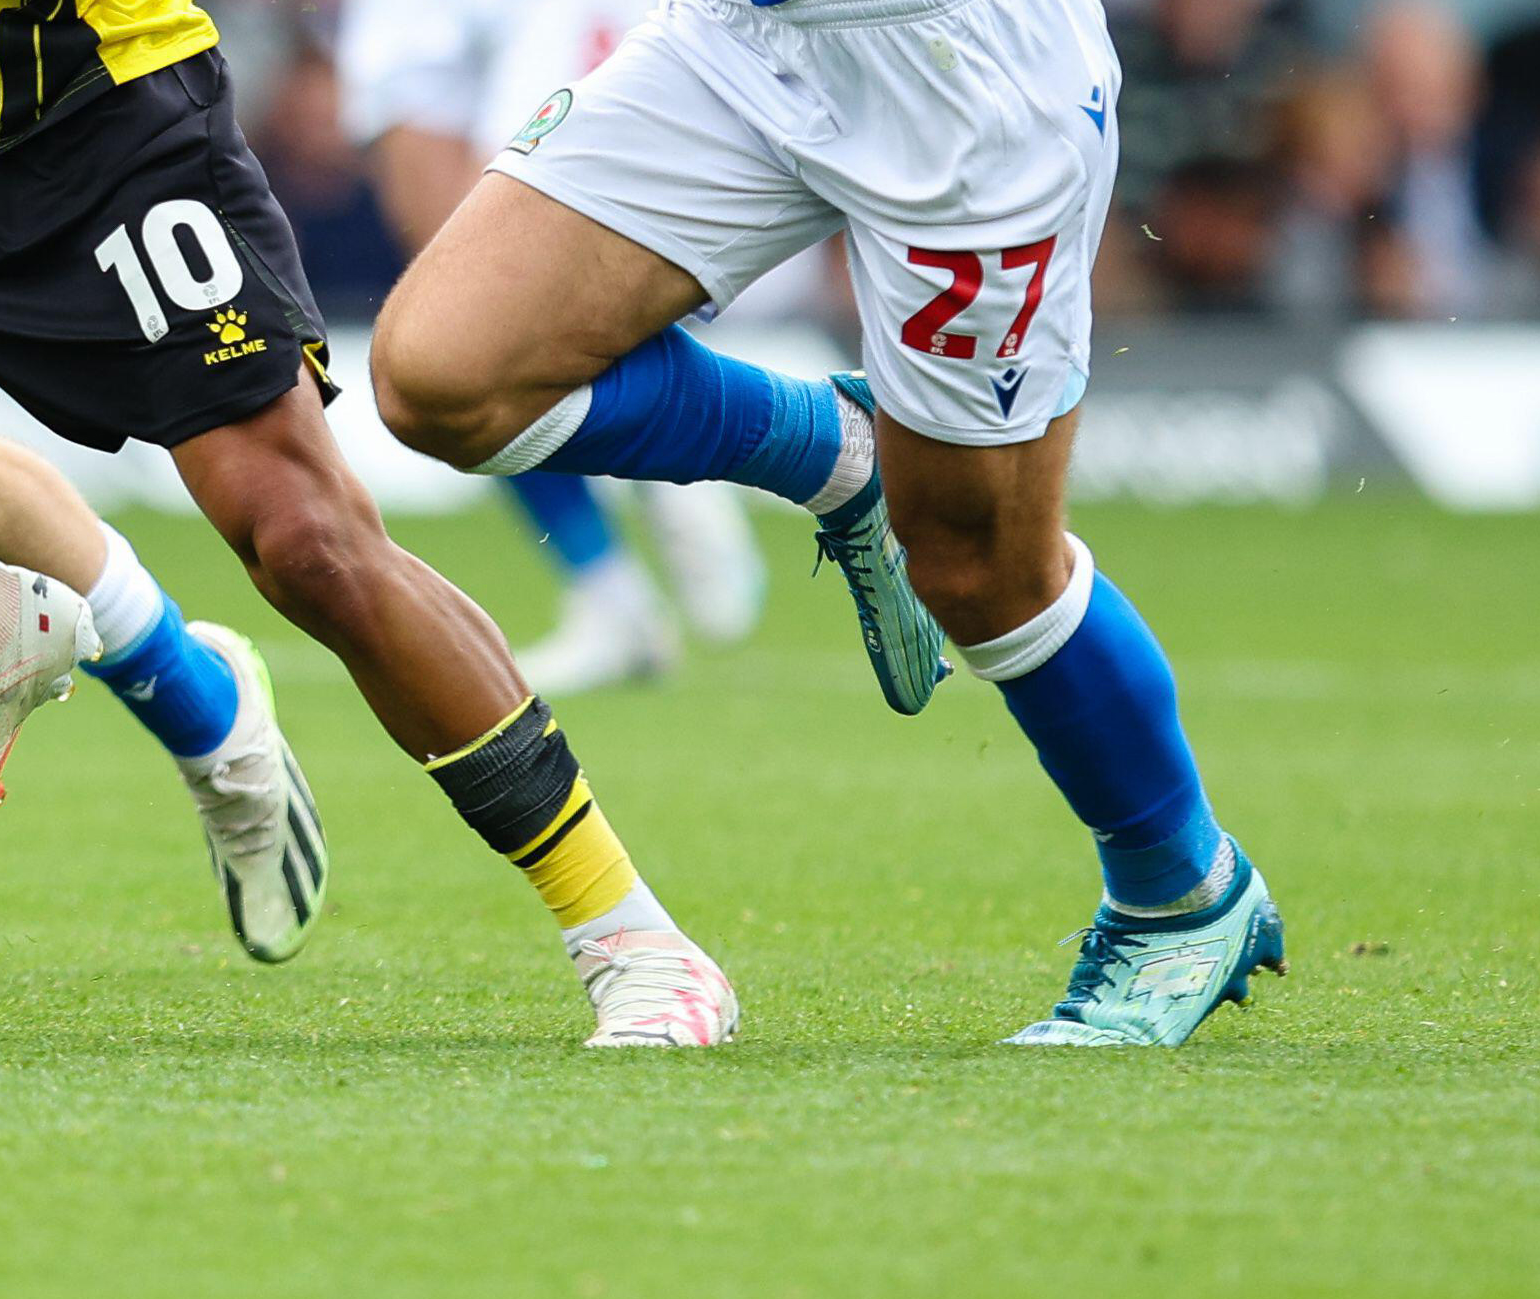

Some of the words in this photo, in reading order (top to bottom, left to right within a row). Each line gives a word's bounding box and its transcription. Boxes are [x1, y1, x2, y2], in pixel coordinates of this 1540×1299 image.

[94, 199, 244, 343] 10
[901, 234, 1058, 360] 27
[203, 339, 268, 366] KELME
